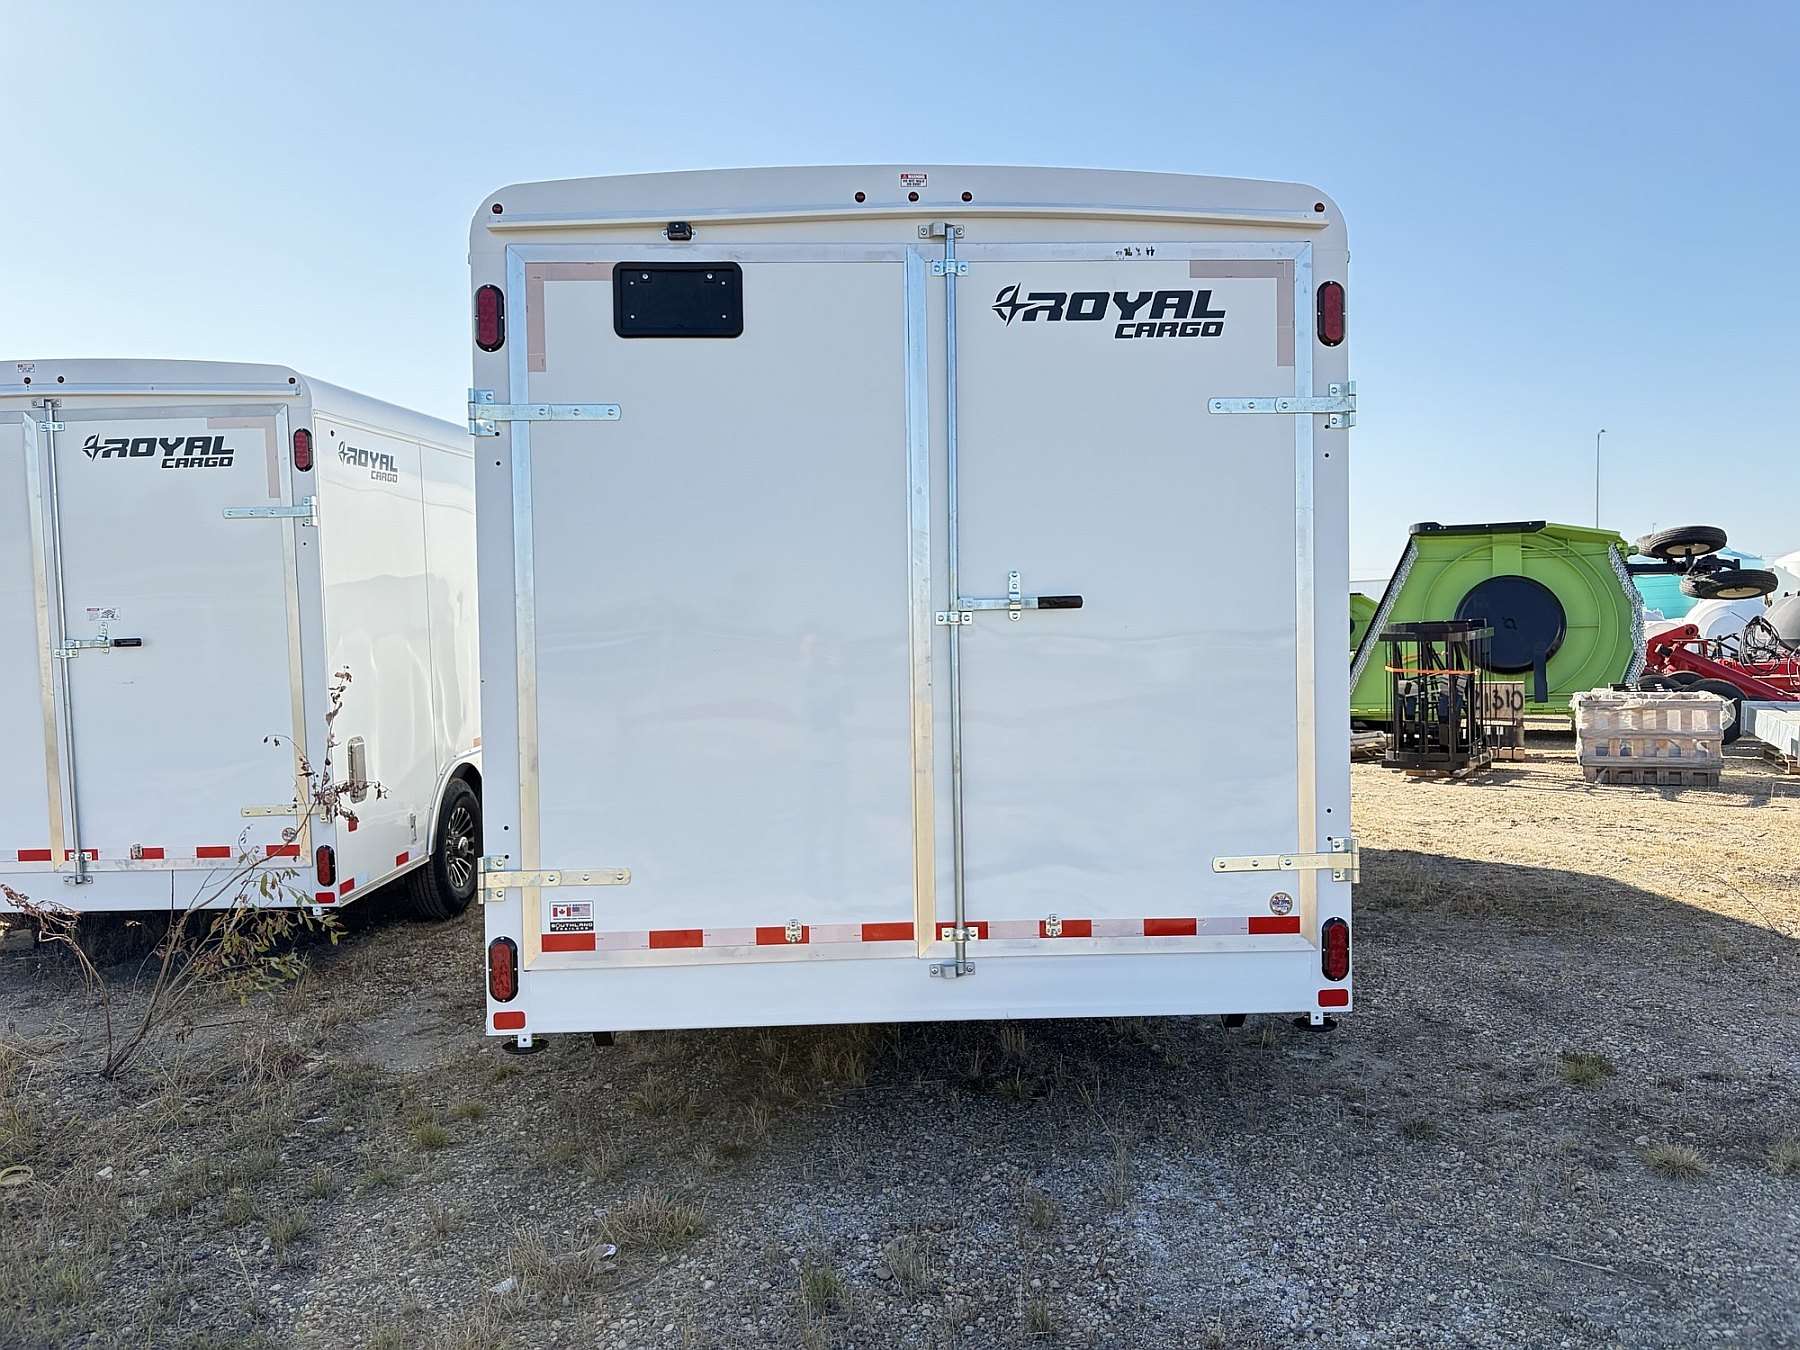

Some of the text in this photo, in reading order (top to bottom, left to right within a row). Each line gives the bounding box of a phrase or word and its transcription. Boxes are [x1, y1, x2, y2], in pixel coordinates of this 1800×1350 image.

[1021, 290, 1226, 321] ROYAL
[1115, 321, 1225, 339] CARGO
[101, 436, 235, 458] ROYAL
[161, 456, 234, 468] CARGO
[346, 446, 399, 473] ROYAL
[370, 470, 398, 483] CARGO
